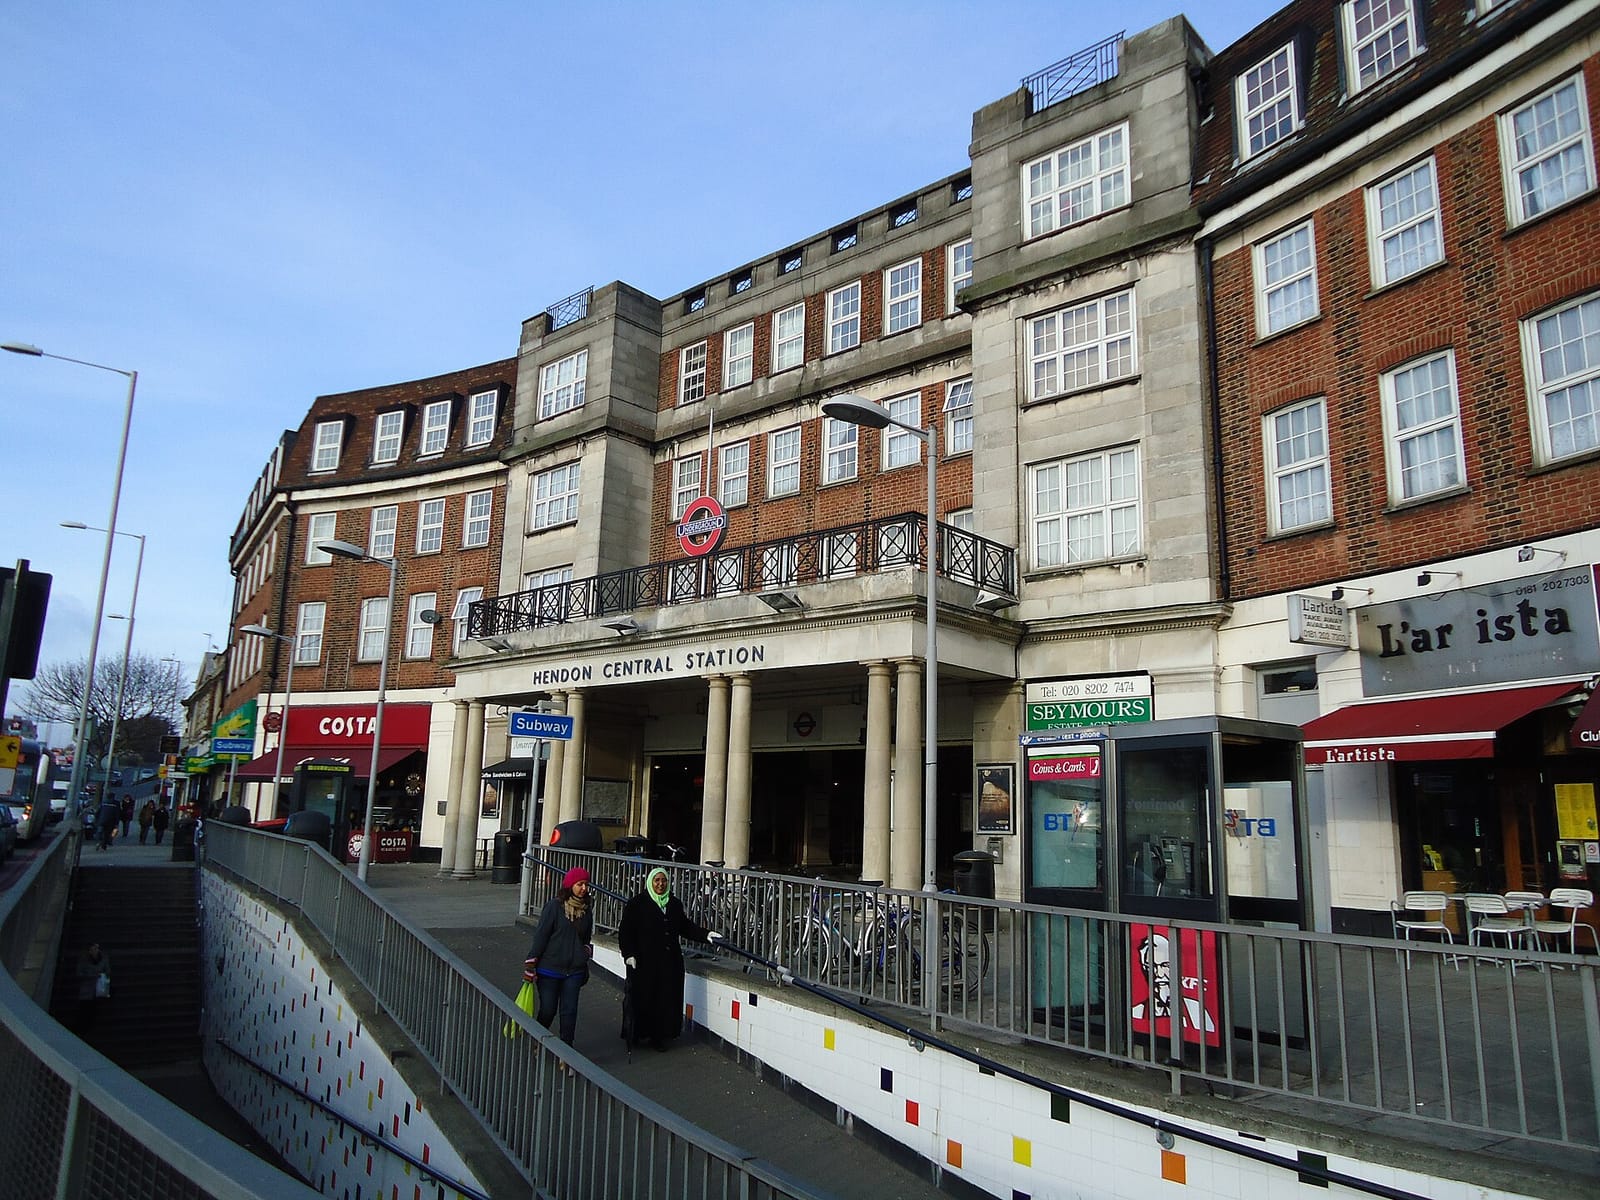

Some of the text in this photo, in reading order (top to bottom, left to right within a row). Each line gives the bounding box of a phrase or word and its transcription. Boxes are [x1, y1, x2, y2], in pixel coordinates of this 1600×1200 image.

[678, 517, 723, 536] UNDERGROUND
[1515, 585, 1537, 596] 0181
[1302, 598, 1343, 616] L'artista
[1303, 614, 1343, 624] TAKE AWAY
[1306, 621, 1342, 631] AVAILABLE
[533, 645, 764, 686] HENDON CENTRAL STATION
[1041, 681, 1134, 697] Tel: 020 8202 7474
[1032, 700, 1145, 721] SEYMOURS
[319, 716, 377, 737] COSTA
[516, 718, 568, 735] Subway
[1580, 730, 1600, 742] Clu
[216, 741, 251, 751] Subway
[1326, 747, 1396, 763] L'artista
[1032, 761, 1086, 775] Coins & Cards
[1044, 813, 1072, 831] BT
[381, 838, 407, 847] COSTA
